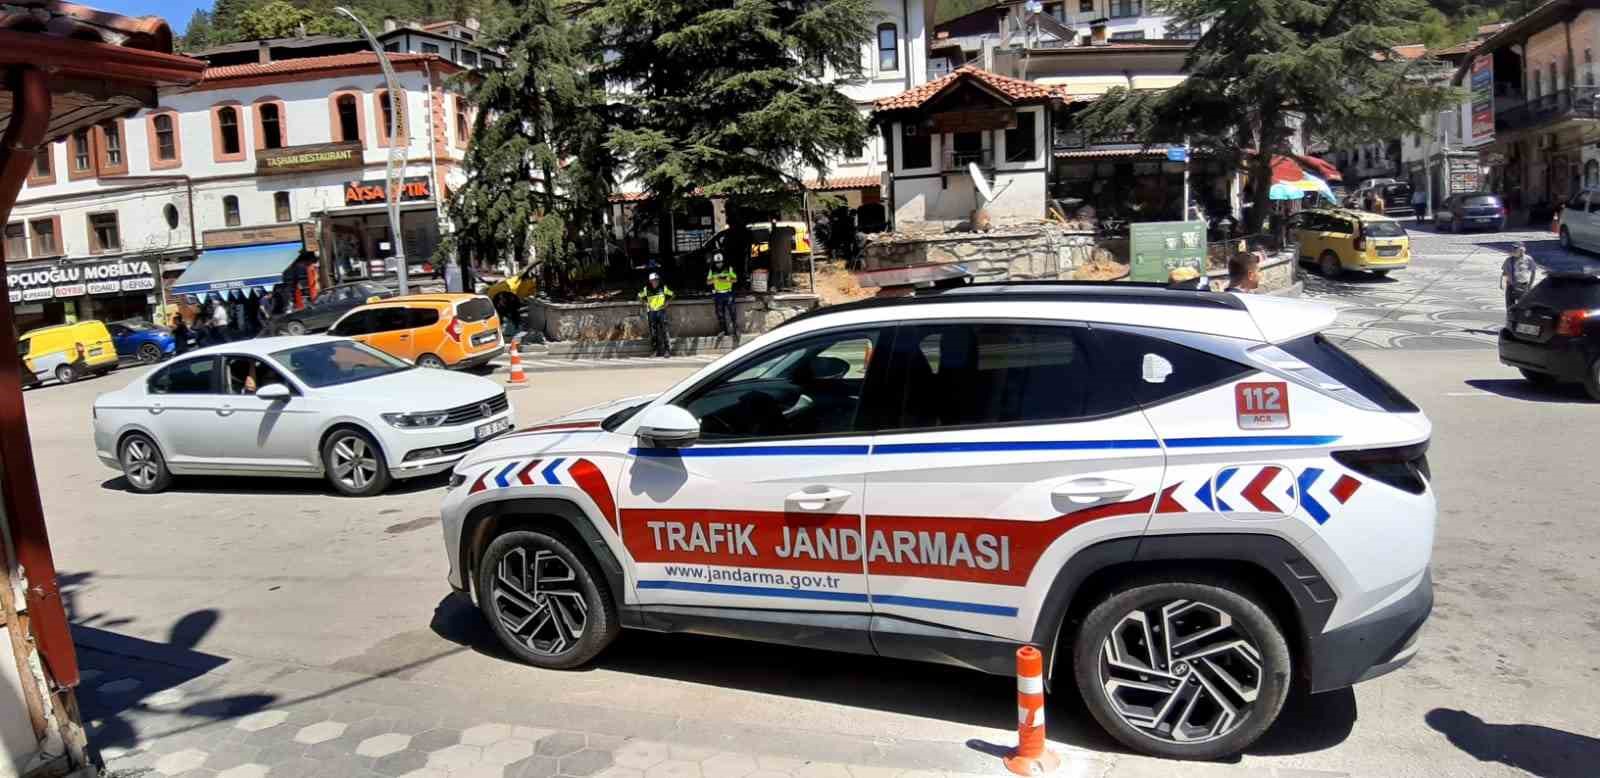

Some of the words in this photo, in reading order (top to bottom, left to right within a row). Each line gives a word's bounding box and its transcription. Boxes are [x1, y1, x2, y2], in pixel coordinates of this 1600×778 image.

[299, 150, 353, 164] RESTAURANT
[346, 181, 386, 201] AYSA
[84, 259, 153, 279] MOBİLYA
[1243, 386, 1281, 410] 112
[775, 525, 1011, 572] JANDARMASI
[664, 564, 841, 589] www.jandarma.gov.tr
